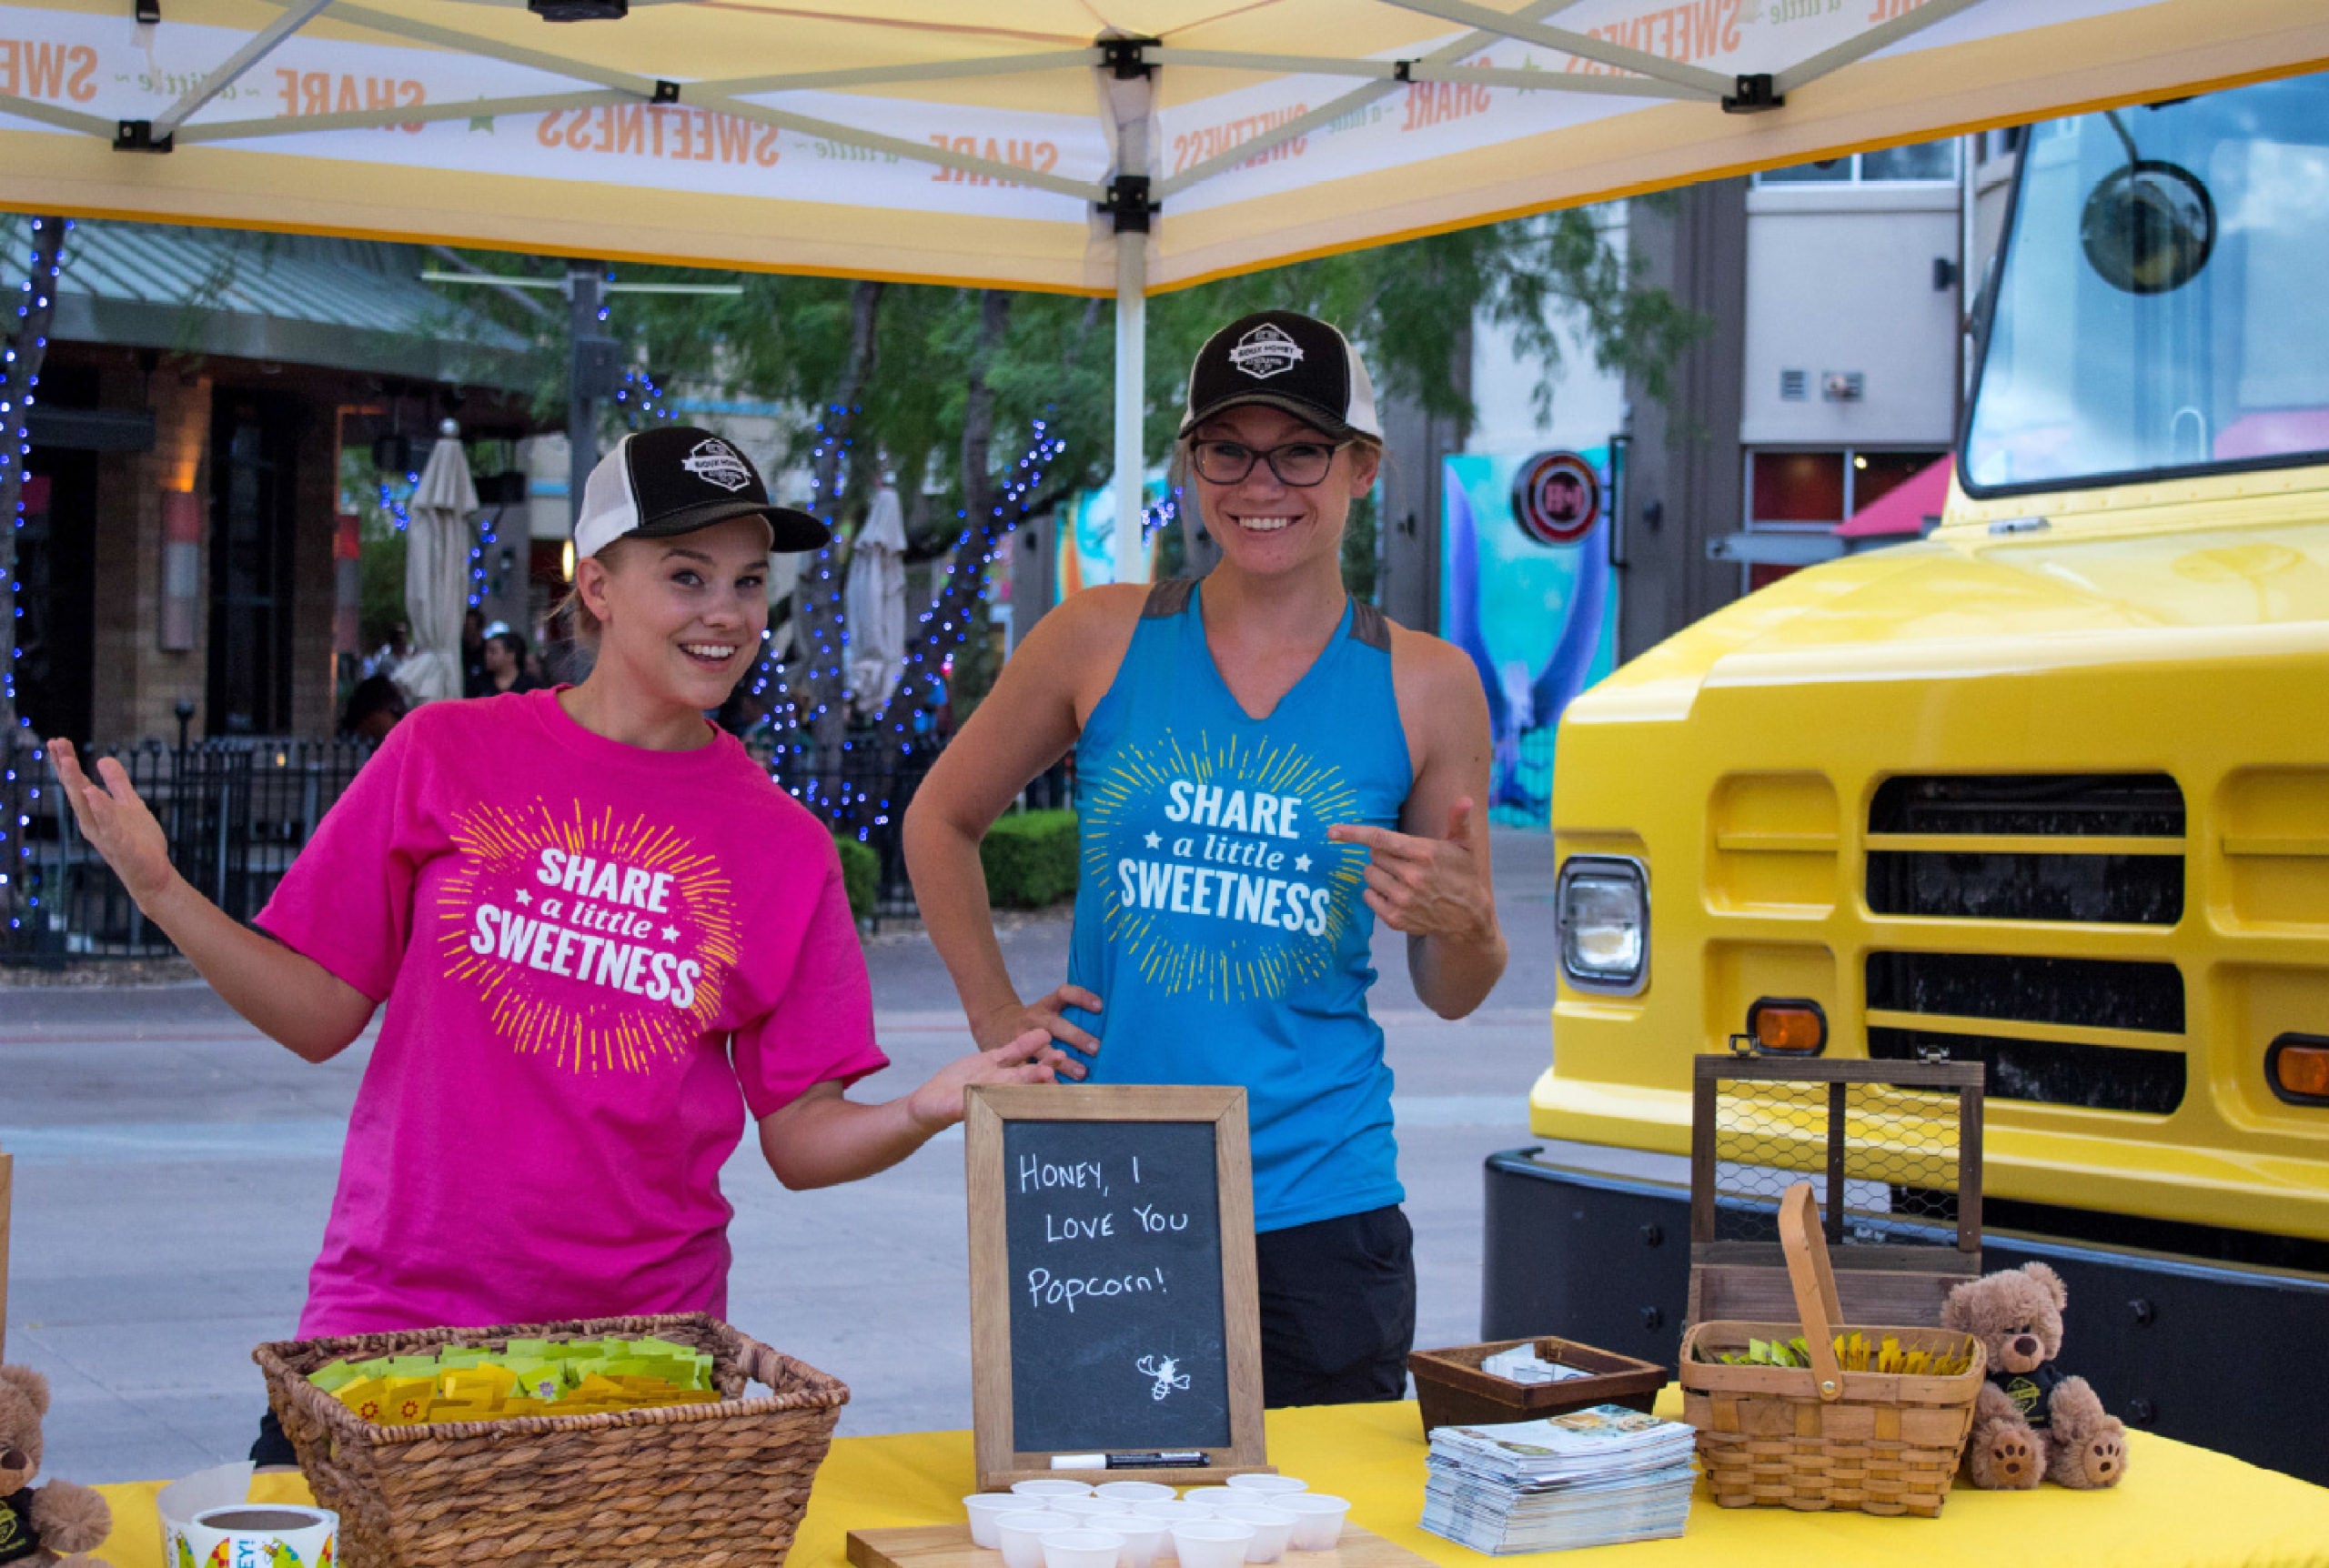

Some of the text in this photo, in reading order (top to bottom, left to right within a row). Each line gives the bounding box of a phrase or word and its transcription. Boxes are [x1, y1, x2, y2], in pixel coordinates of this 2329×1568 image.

[1164, 780, 1302, 839] SHARE
[1173, 834, 1285, 871] a little
[537, 848, 674, 913] SHARE
[1118, 858, 1330, 937] SWEETNESS
[540, 899, 653, 939] a little
[469, 903, 701, 1010] SWEETNESS
[1020, 1153, 1141, 1197] HONEY, I
[1045, 1212, 1114, 1243] LOVE
[1028, 1266, 1168, 1313] Popcorn!
